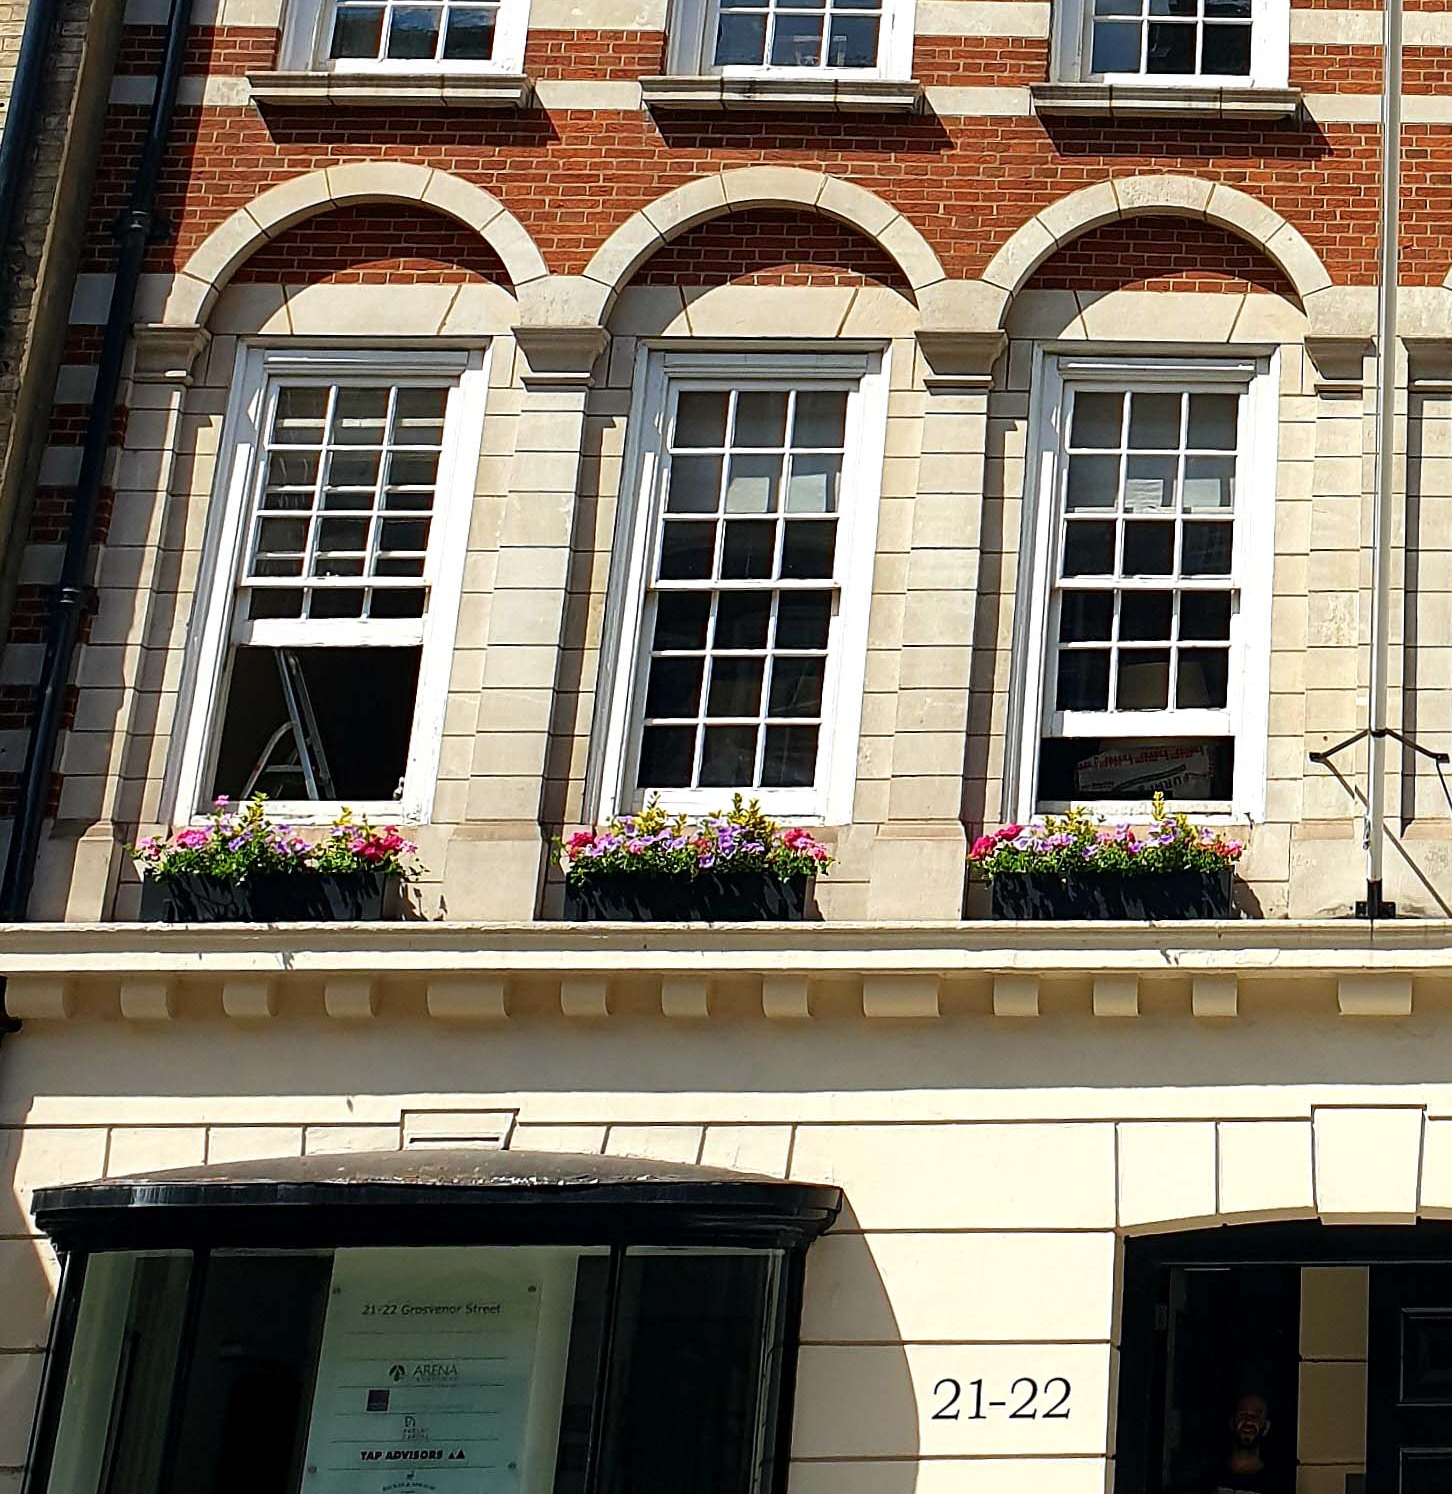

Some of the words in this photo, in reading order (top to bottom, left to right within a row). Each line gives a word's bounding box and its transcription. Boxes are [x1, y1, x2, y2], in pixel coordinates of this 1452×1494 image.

[362, 1304, 397, 1315] 21-22
[401, 1304, 461, 1315] Grosvenor
[465, 1303, 501, 1315] Street
[413, 1364, 458, 1375] ARENA
[931, 1377, 1071, 1420] 21-22
[385, 1449, 443, 1460] ADVISORS
